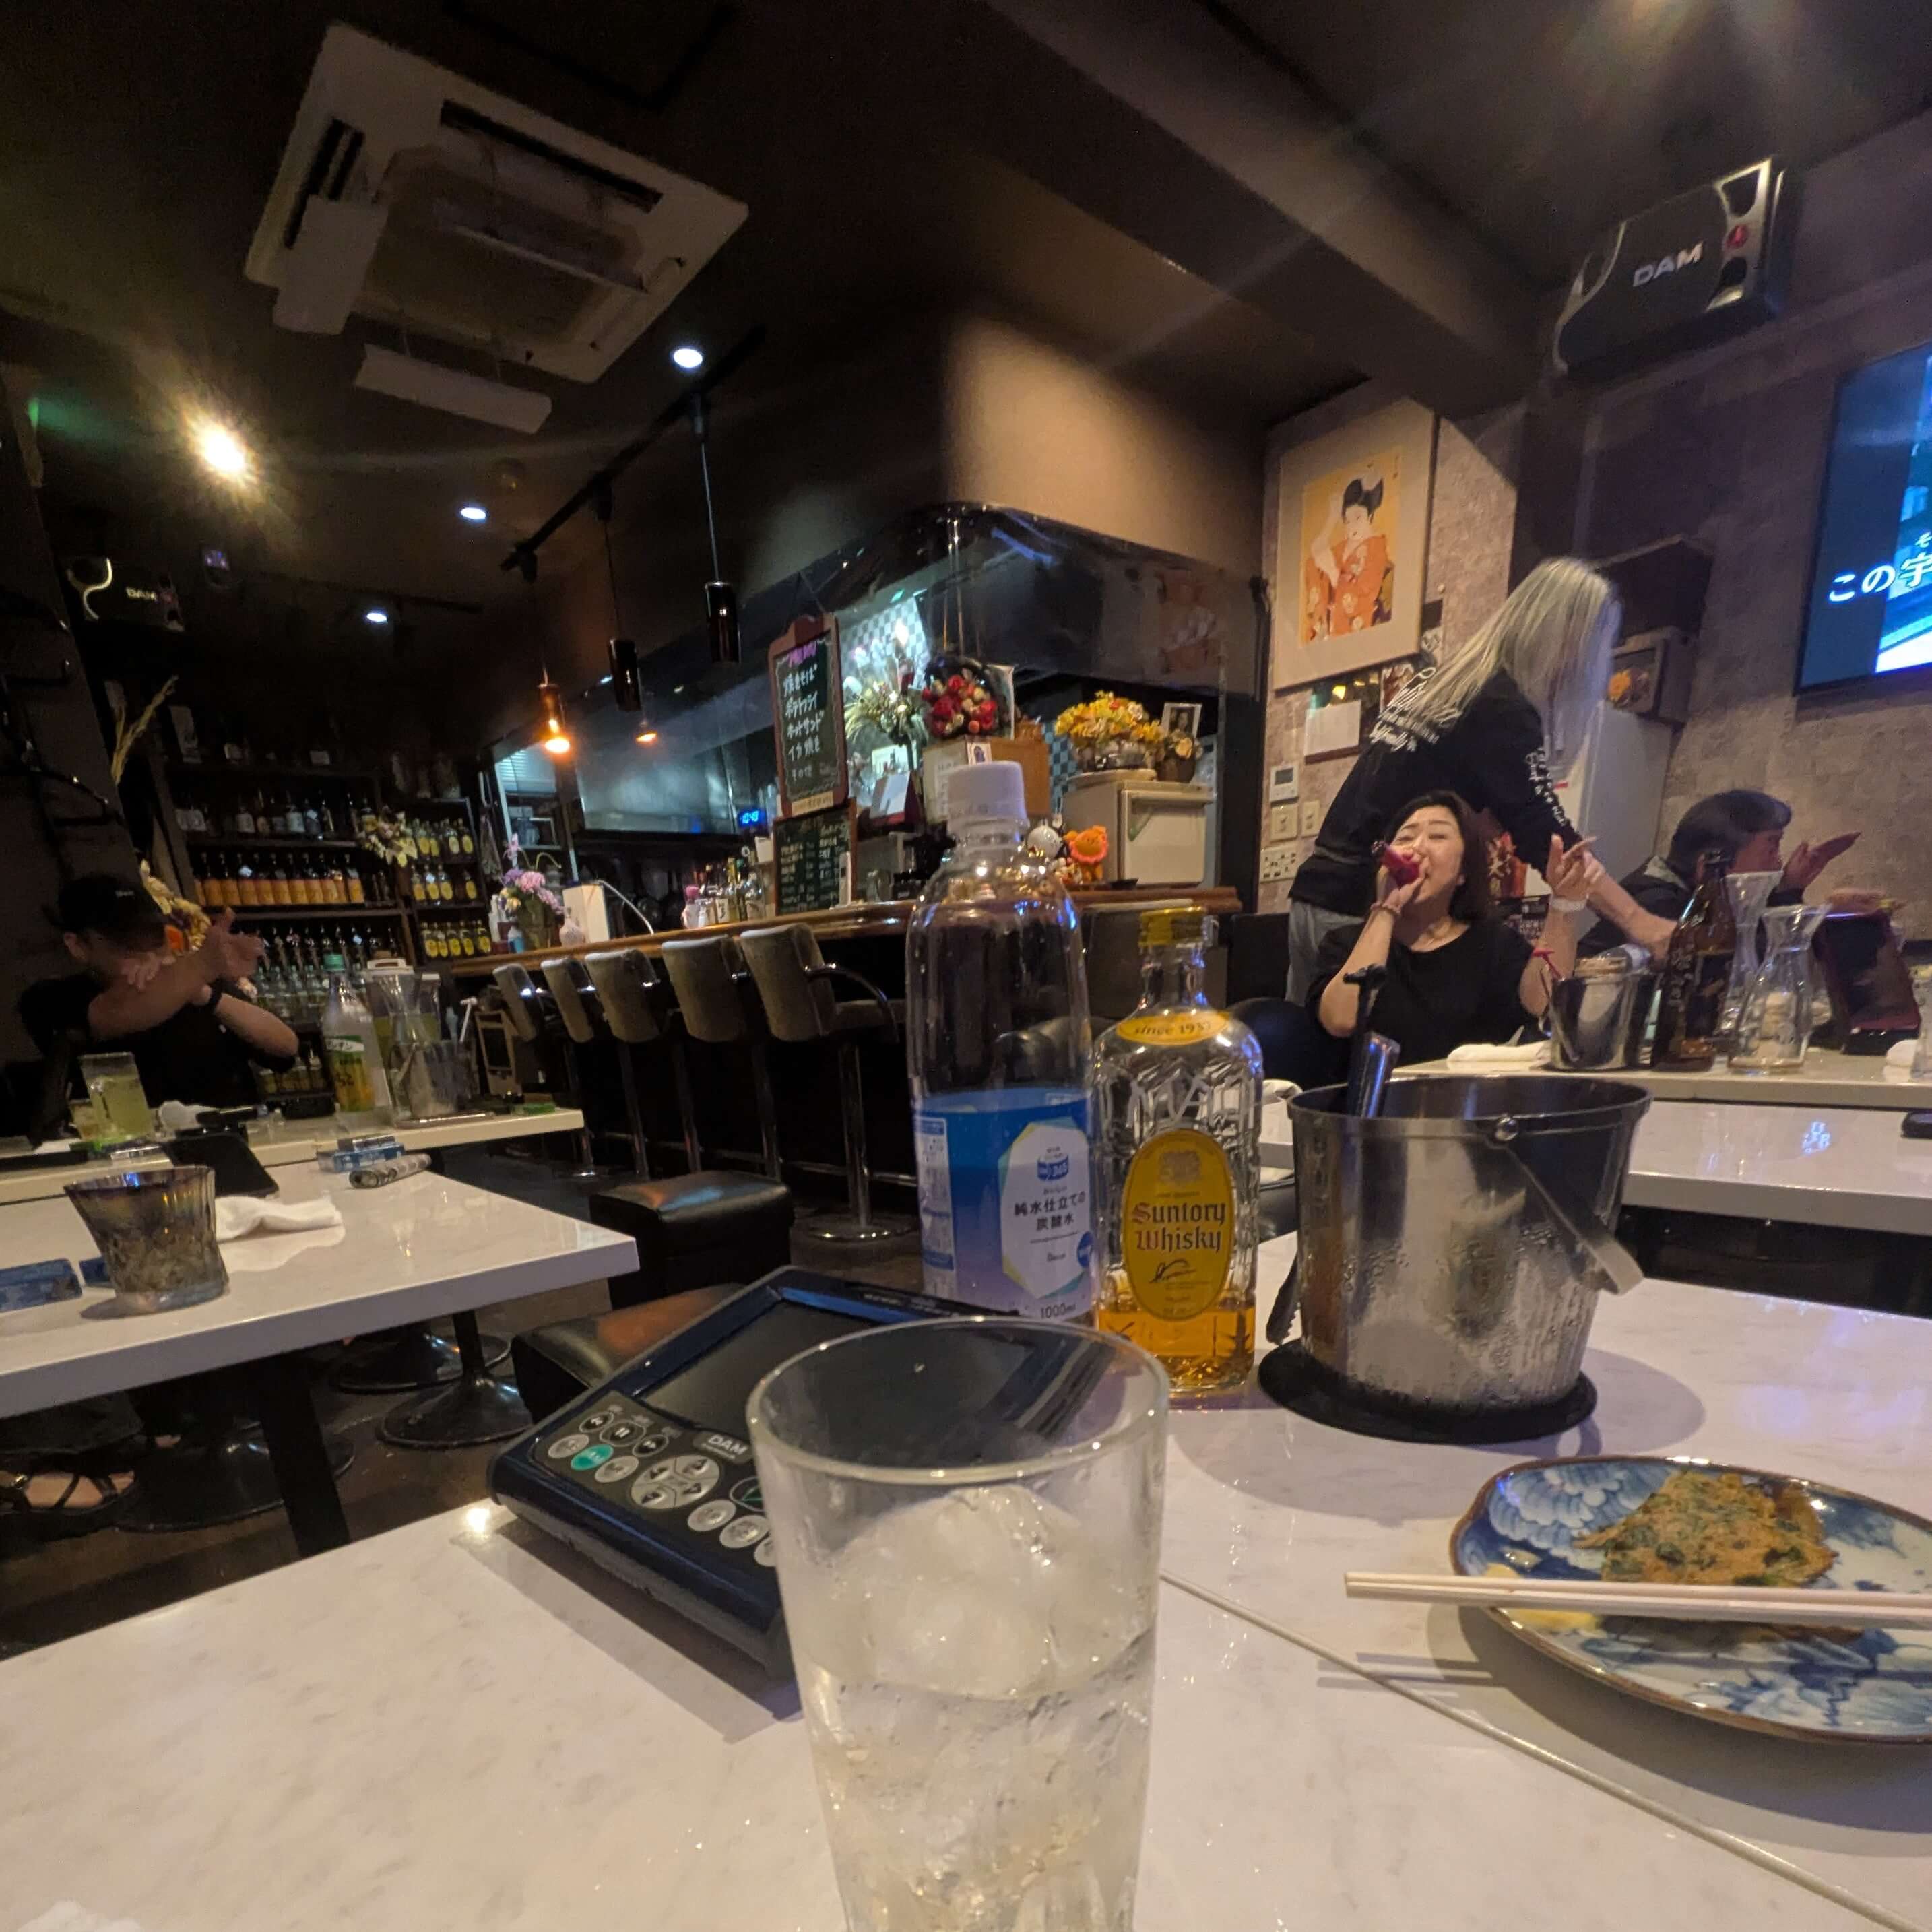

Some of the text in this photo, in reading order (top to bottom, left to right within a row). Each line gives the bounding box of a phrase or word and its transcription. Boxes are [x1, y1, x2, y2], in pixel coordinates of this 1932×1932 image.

[1632, 240, 1704, 288] DAM
[785, 690, 818, 719] ポテトフライ
[1133, 1025, 1173, 1035] since
[1014, 1190, 1085, 1217] 純水仕立ての
[1131, 1201, 1226, 1226] Suntory
[1036, 1212, 1074, 1232] 炭酸水
[1134, 1225, 1221, 1254] Whisky
[707, 1434, 748, 1455] DAM
